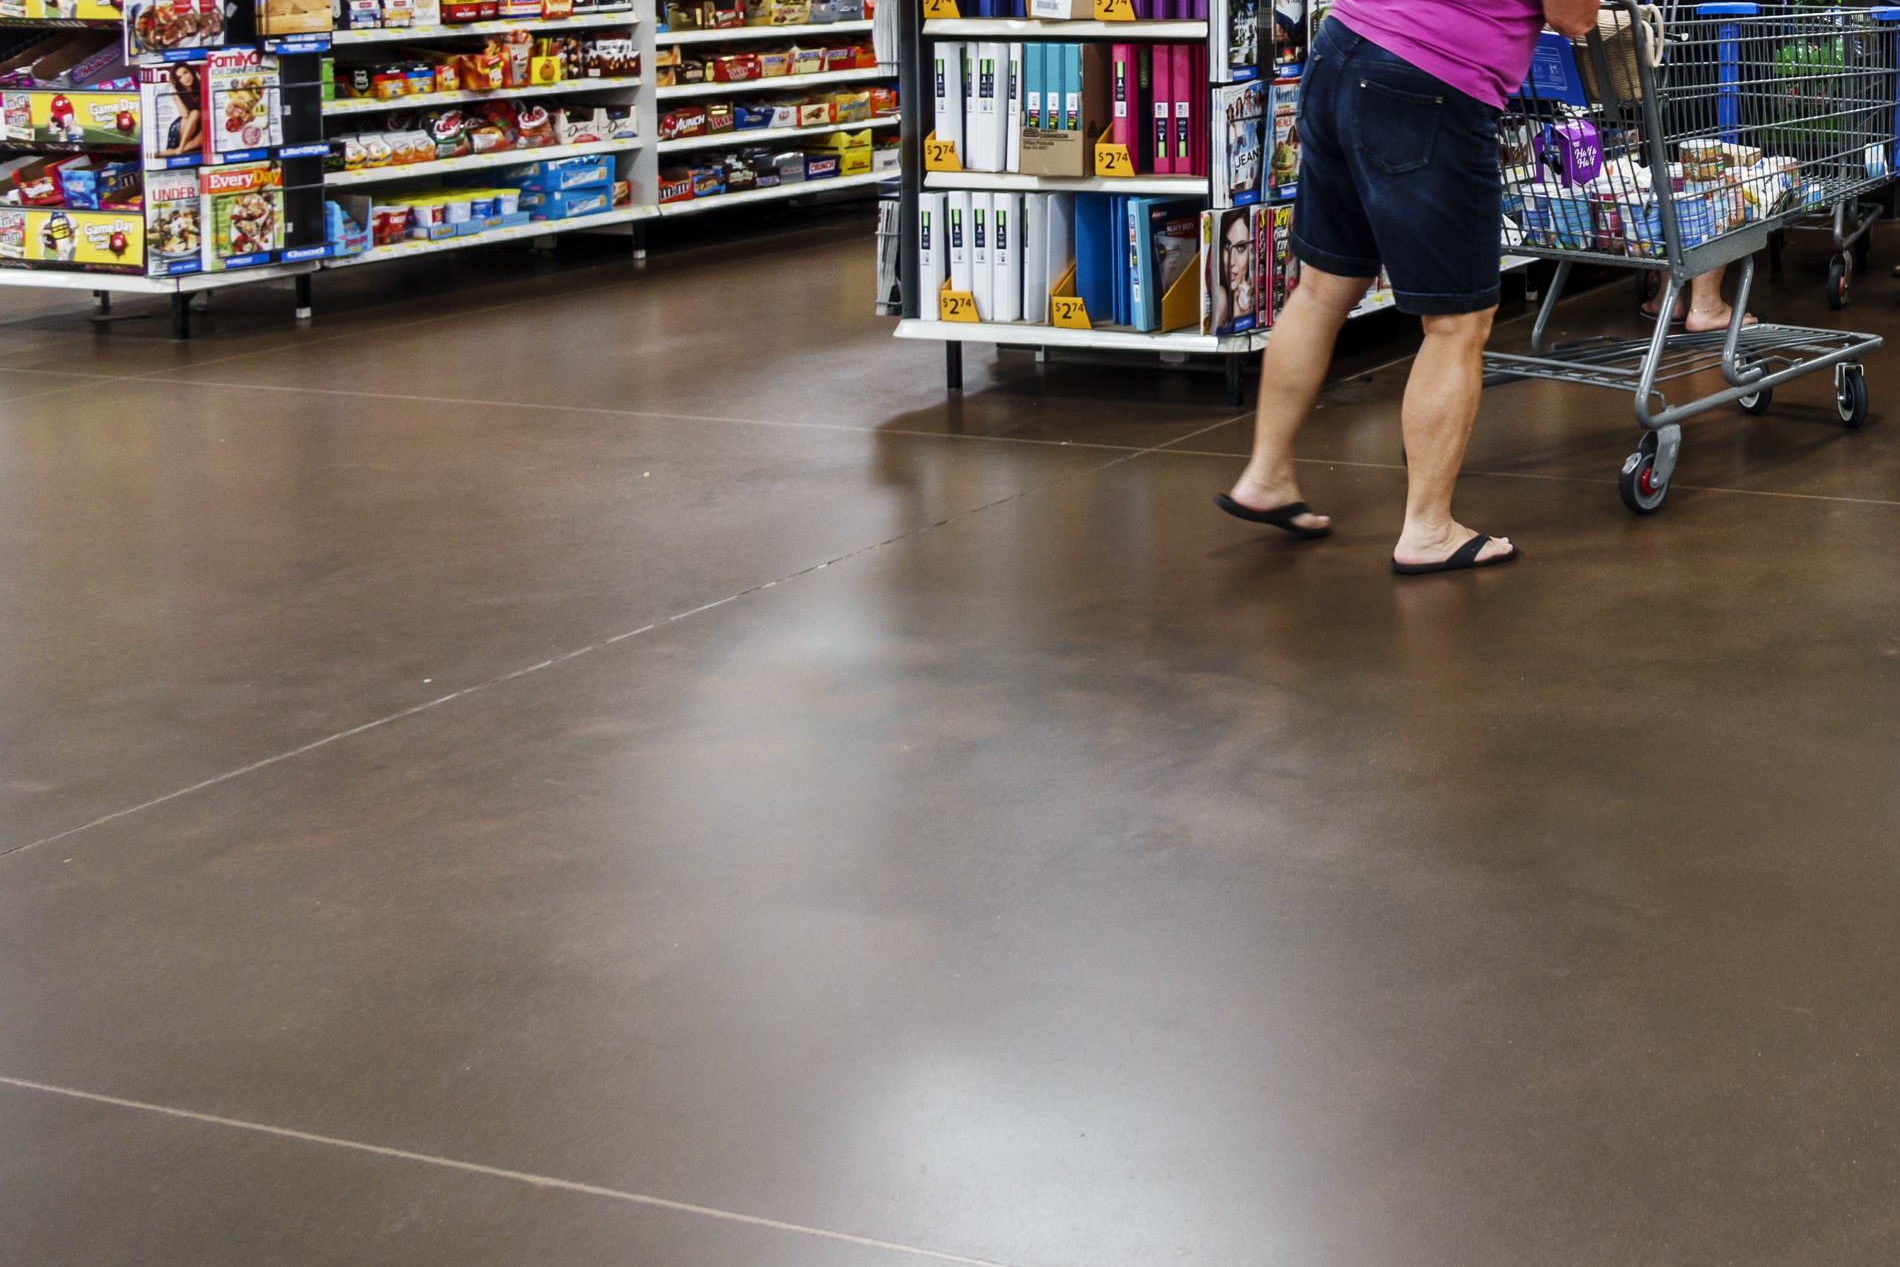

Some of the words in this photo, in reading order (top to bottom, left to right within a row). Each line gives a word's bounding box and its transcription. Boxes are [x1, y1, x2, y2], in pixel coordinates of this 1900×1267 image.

[90, 102, 120, 115] Game
[120, 98, 140, 112] Day
[1276, 118, 1293, 128] MEALS
[84, 222, 114, 235] Game
[115, 219, 135, 233] Day
[287, 247, 325, 258] Good
